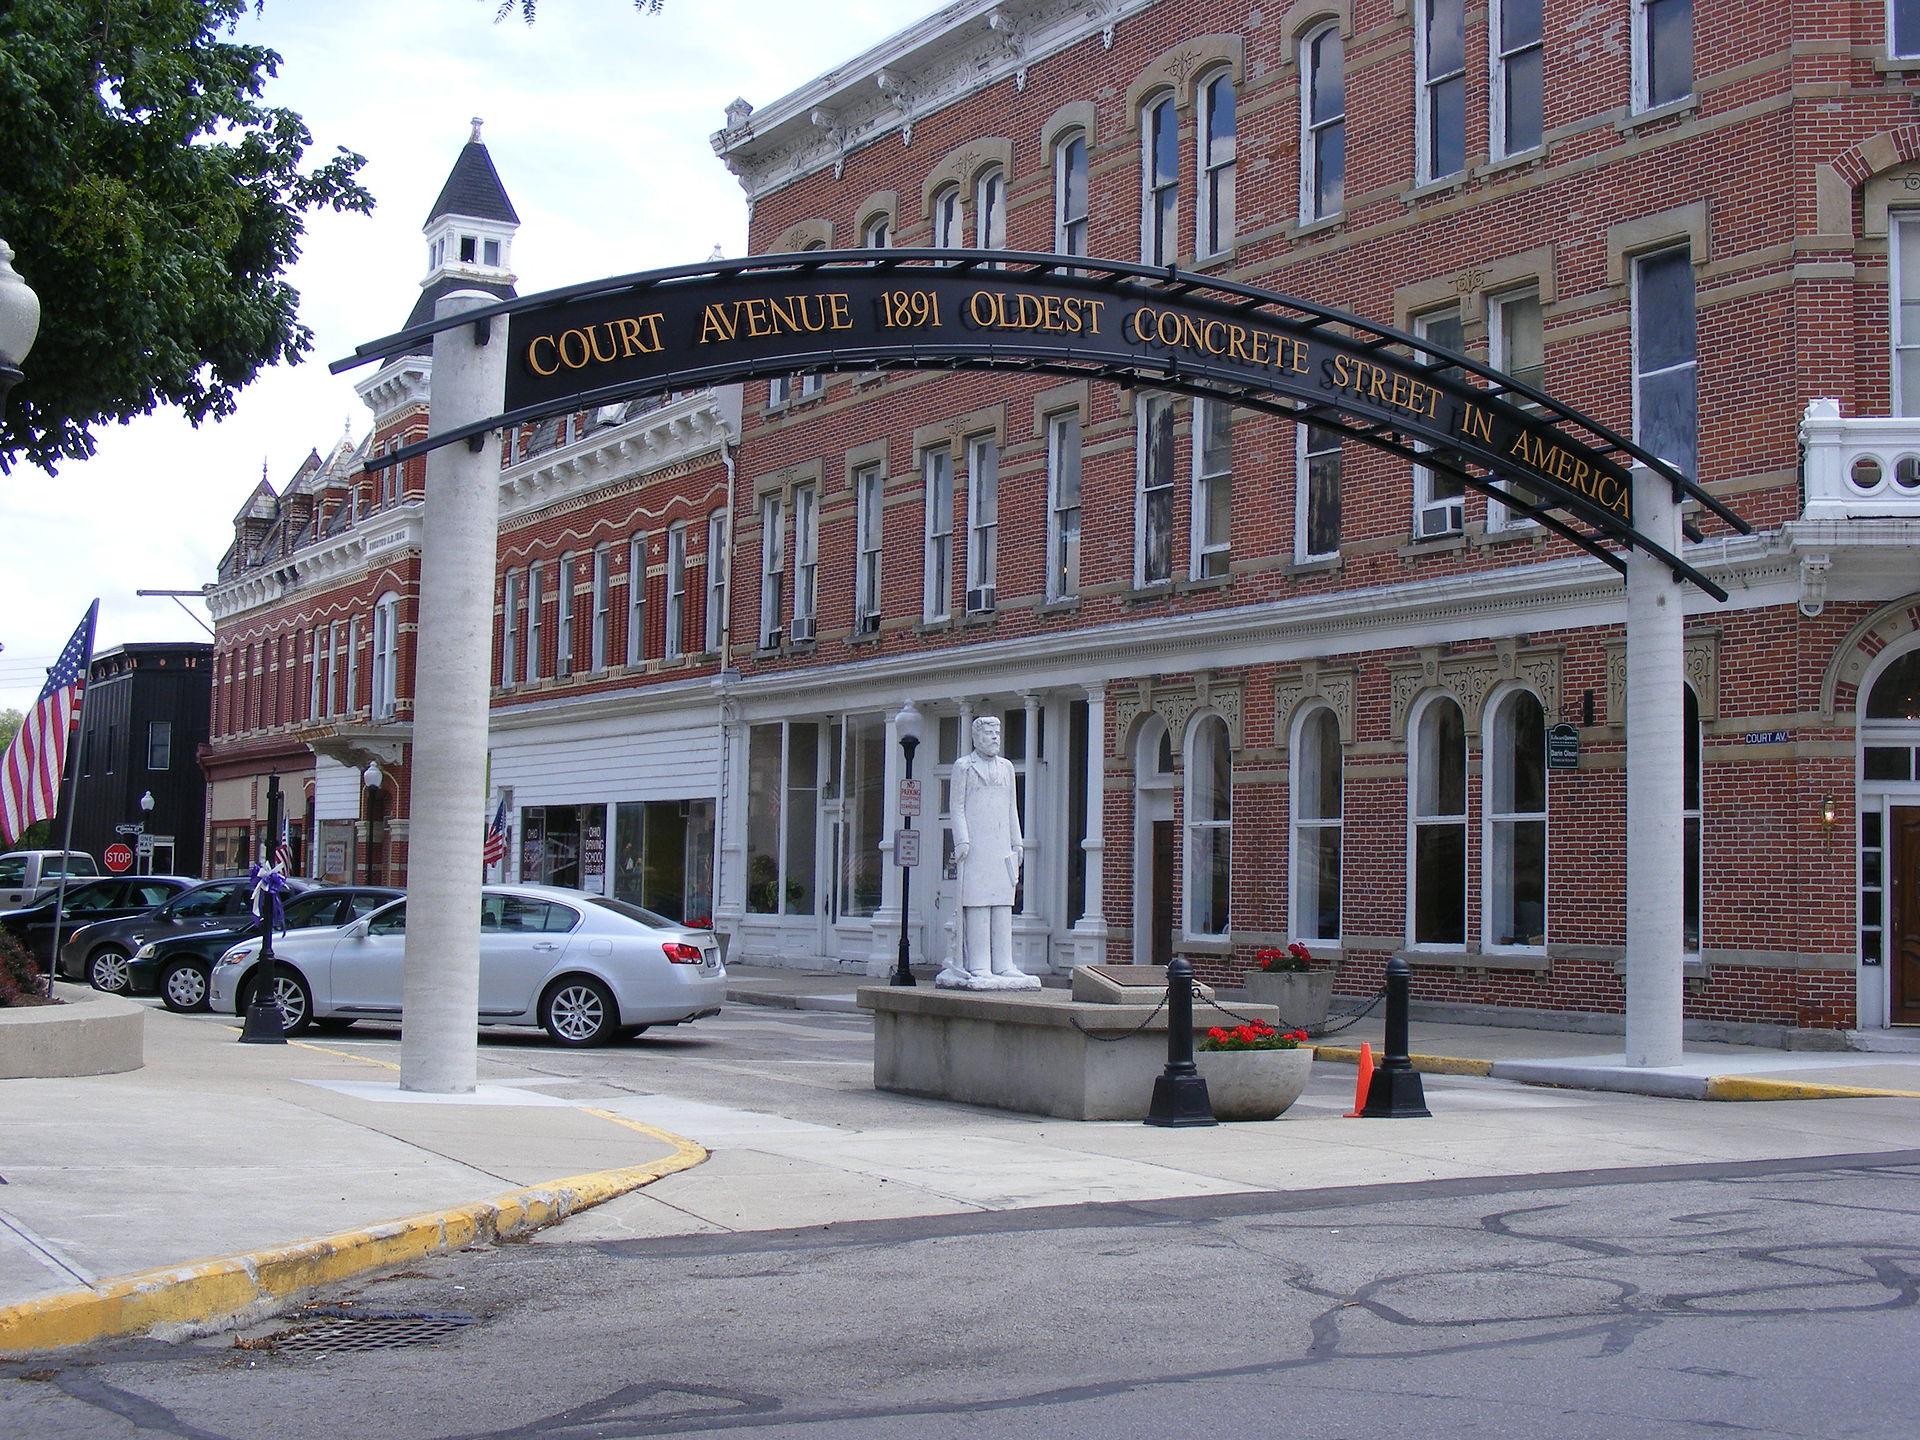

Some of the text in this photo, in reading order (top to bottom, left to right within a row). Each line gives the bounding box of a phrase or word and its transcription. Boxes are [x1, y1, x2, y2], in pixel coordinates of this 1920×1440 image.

[528, 290, 1631, 520] COURT AVENUE 1891 OLDEST CONCRETE STREET IN AMERICA
[1746, 732, 1772, 744] COURT
[588, 826, 600, 838] OHIO
[585, 840, 604, 850] DRIVING
[107, 852, 130, 863] STOP
[584, 852, 604, 862] SCHOOL
